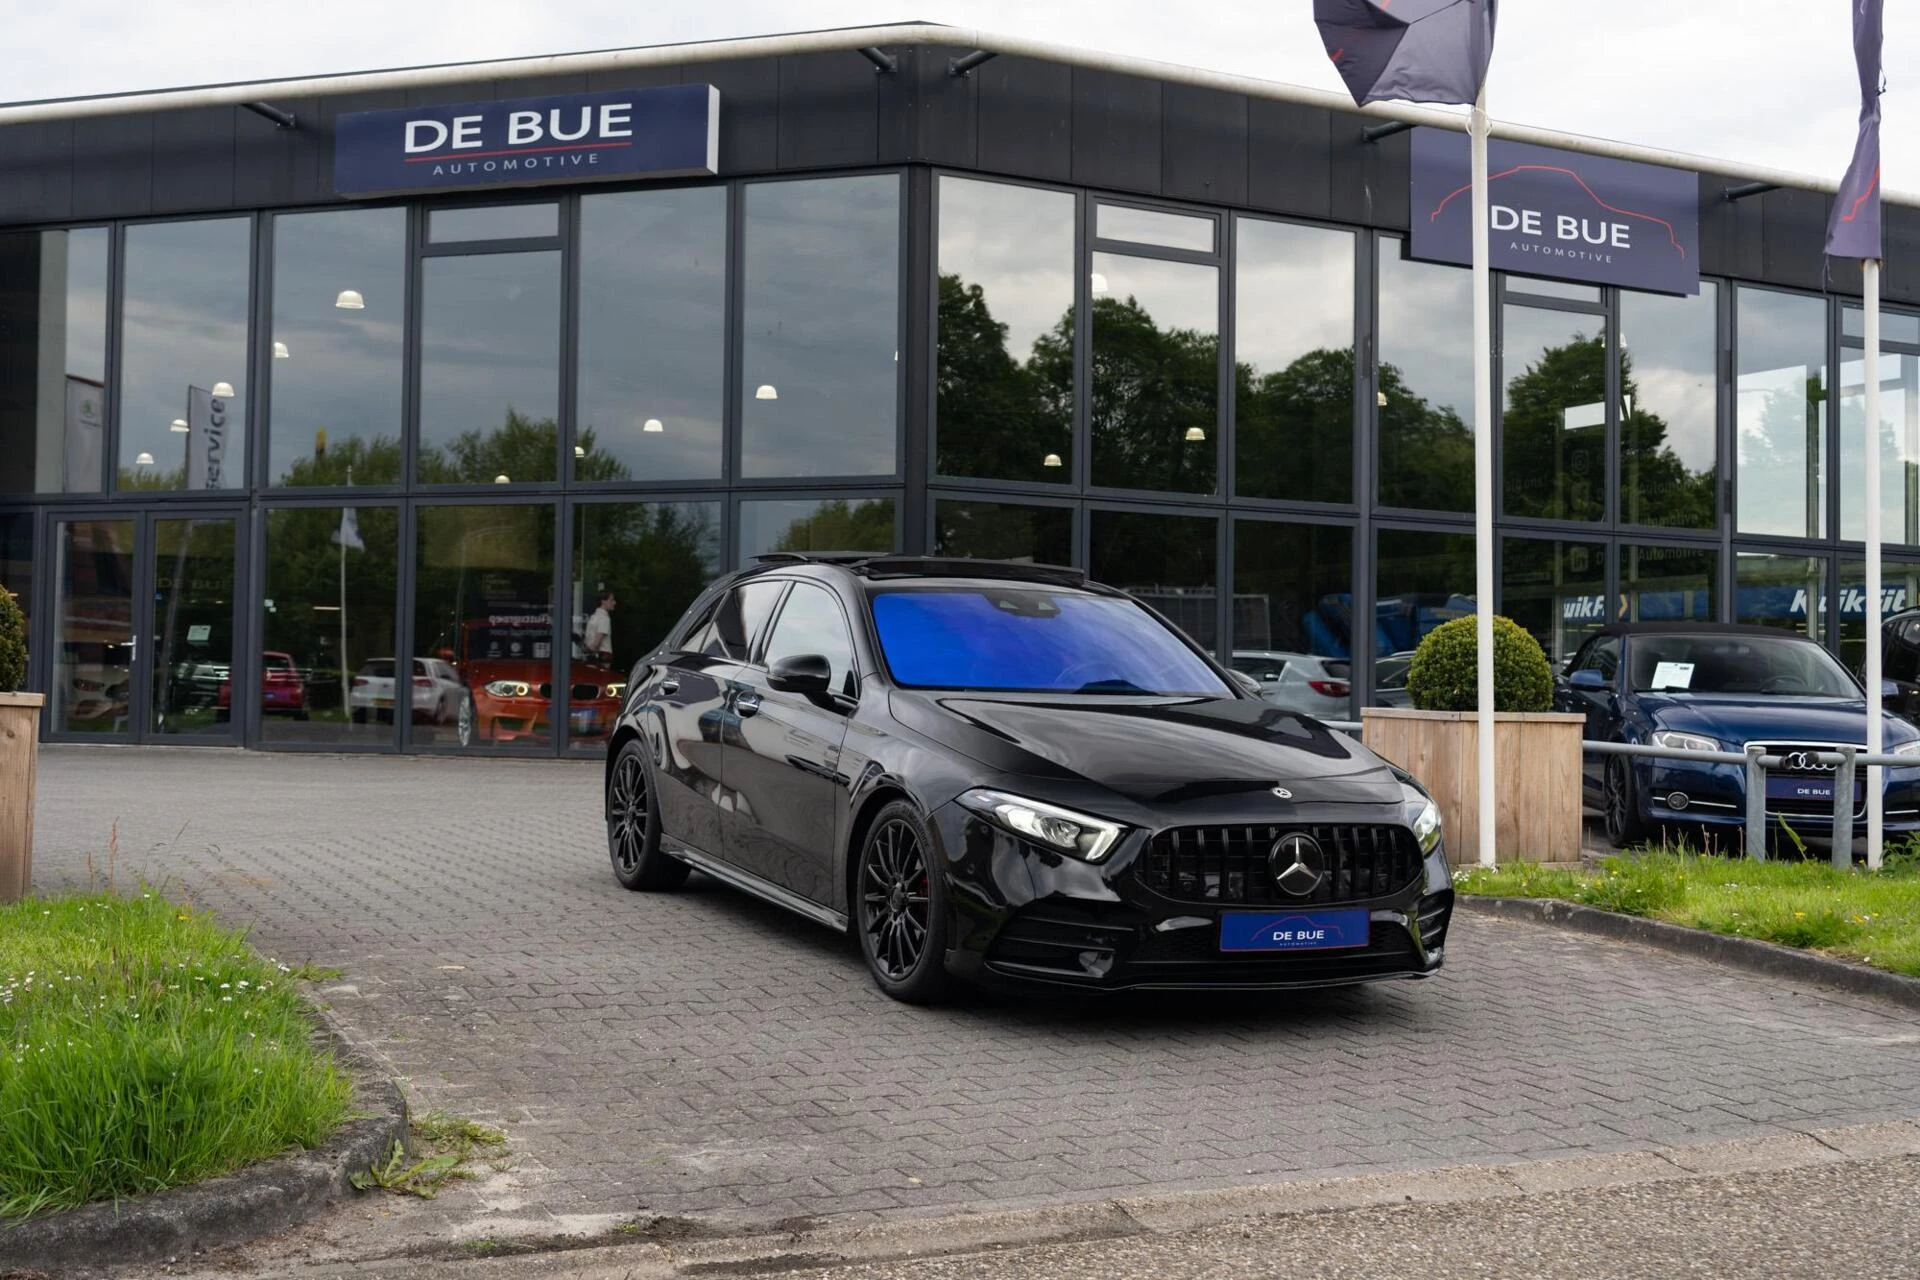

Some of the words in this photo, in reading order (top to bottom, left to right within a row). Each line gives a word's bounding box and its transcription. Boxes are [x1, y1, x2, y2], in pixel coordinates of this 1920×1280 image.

[404, 115, 483, 154] DE
[508, 103, 632, 145] BUE
[432, 152, 599, 176] AUTOMOTIVE
[1491, 205, 1542, 236] DE
[1557, 215, 1631, 249] BUE
[1510, 242, 1612, 264] AUTOMOTIVE
[1812, 788, 1831, 796] BUE
[1273, 931, 1292, 940] DE
[1297, 930, 1324, 940] BUE
